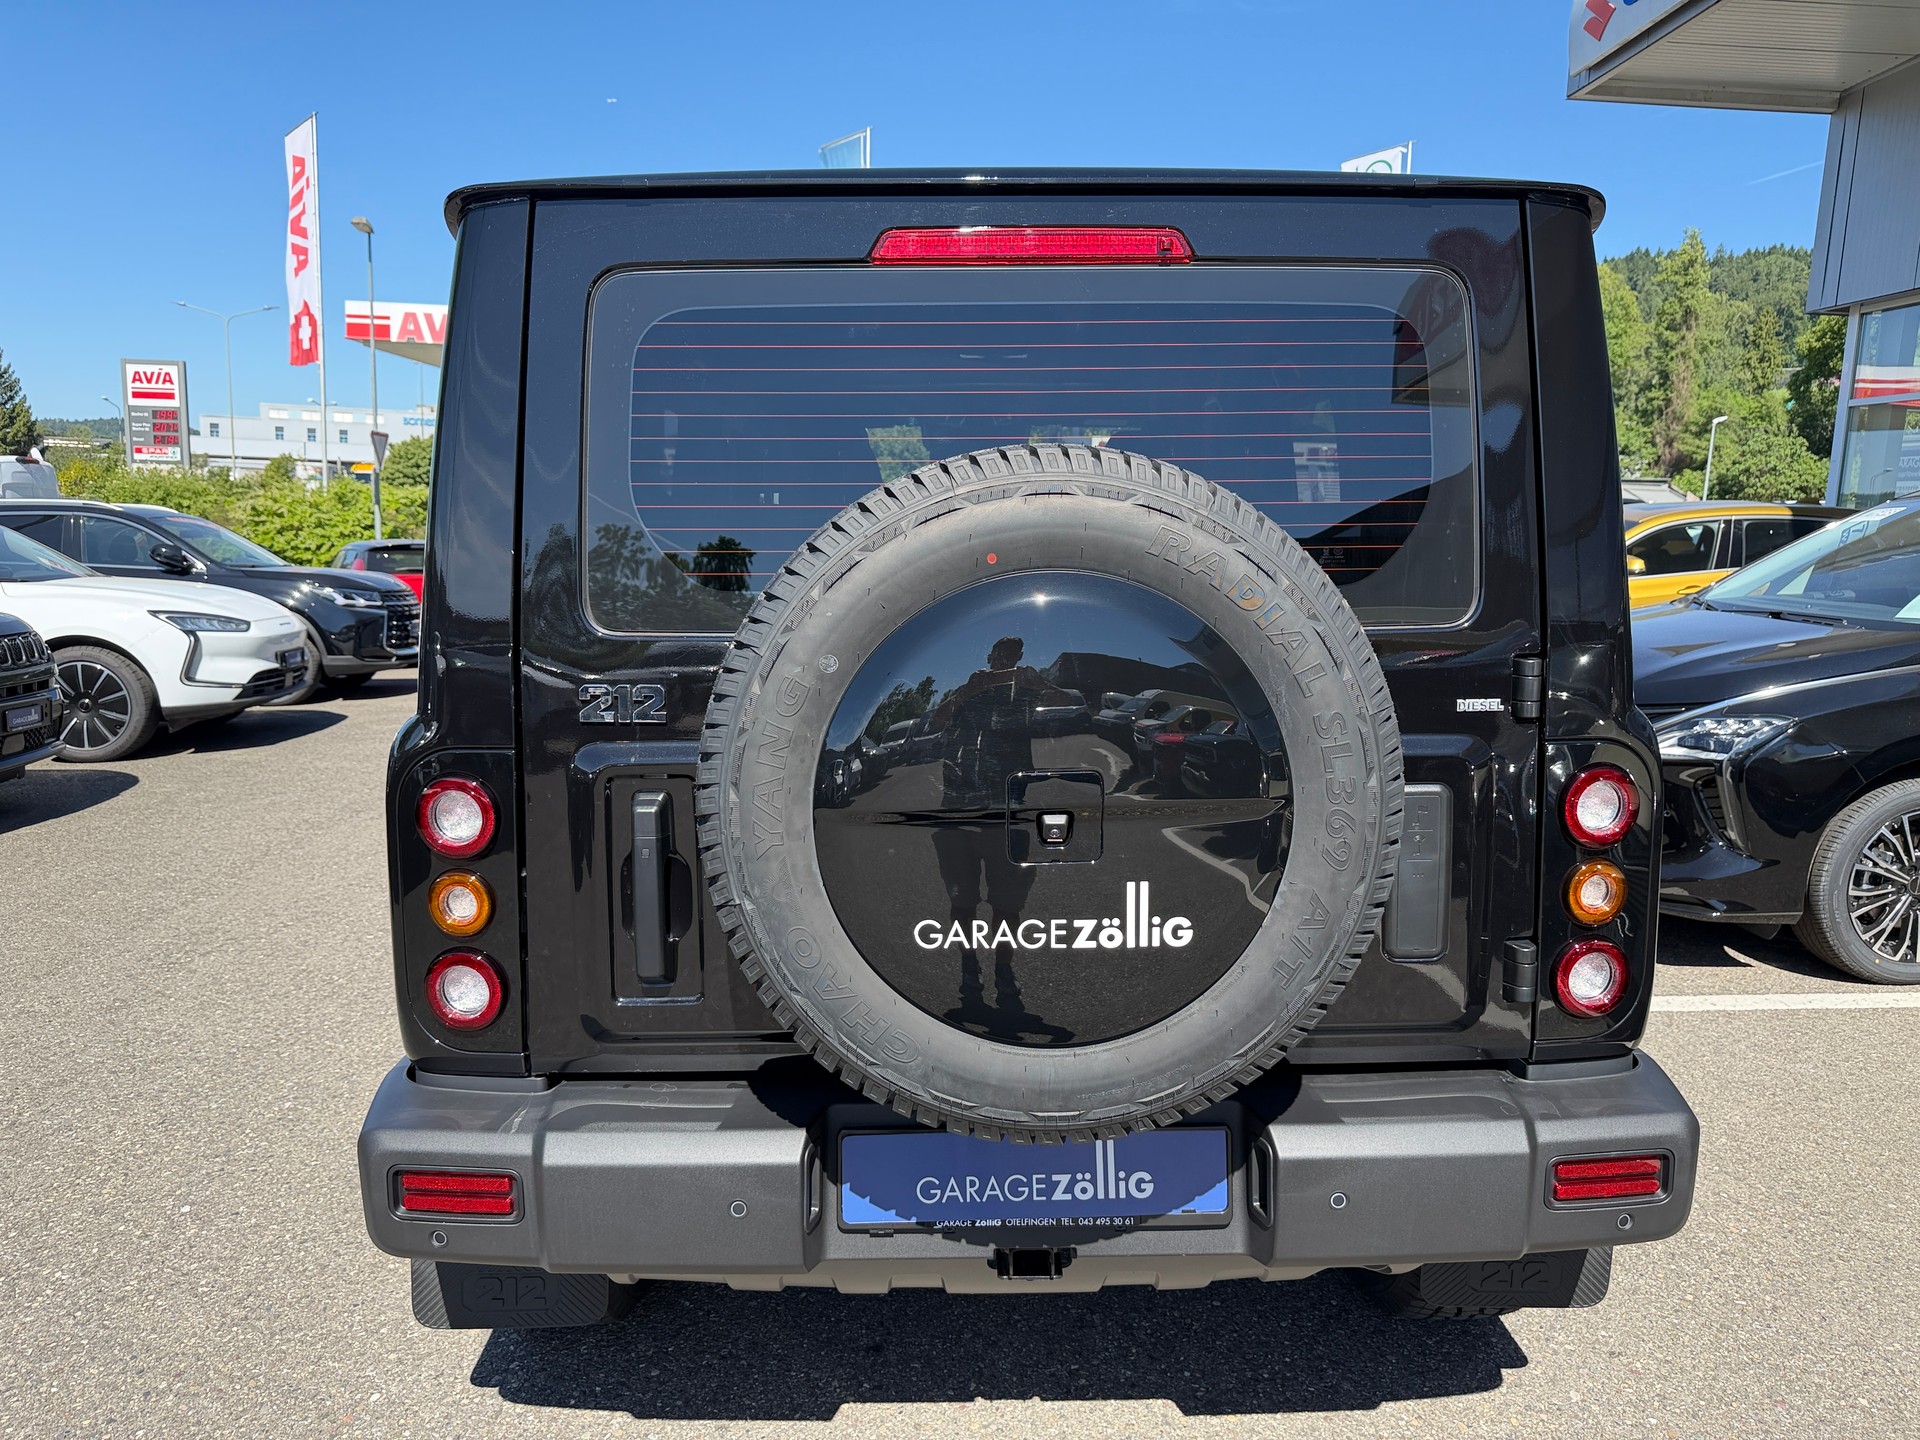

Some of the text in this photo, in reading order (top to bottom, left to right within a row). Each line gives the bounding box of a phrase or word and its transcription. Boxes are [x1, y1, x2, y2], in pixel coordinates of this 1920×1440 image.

[579, 684, 667, 722] 212
[1456, 698, 1504, 712] DIESEL
[752, 674, 810, 861] YANG
[1145, 524, 1356, 991] RADIAL SL369 A/T
[913, 919, 1067, 949] GARAGE
[916, 1174, 1047, 1204] GARAGE
[936, 1219, 973, 1227] GARAGE
[1006, 1217, 1056, 1226] OTELFINGEN
[1078, 1217, 1093, 1226] 043
[1096, 1217, 1110, 1225] 495
[1113, 1217, 1123, 1225] 30
[1125, 1216, 1134, 1225] 61
[1480, 1261, 1549, 1288] 212
[474, 1275, 547, 1307] 212
